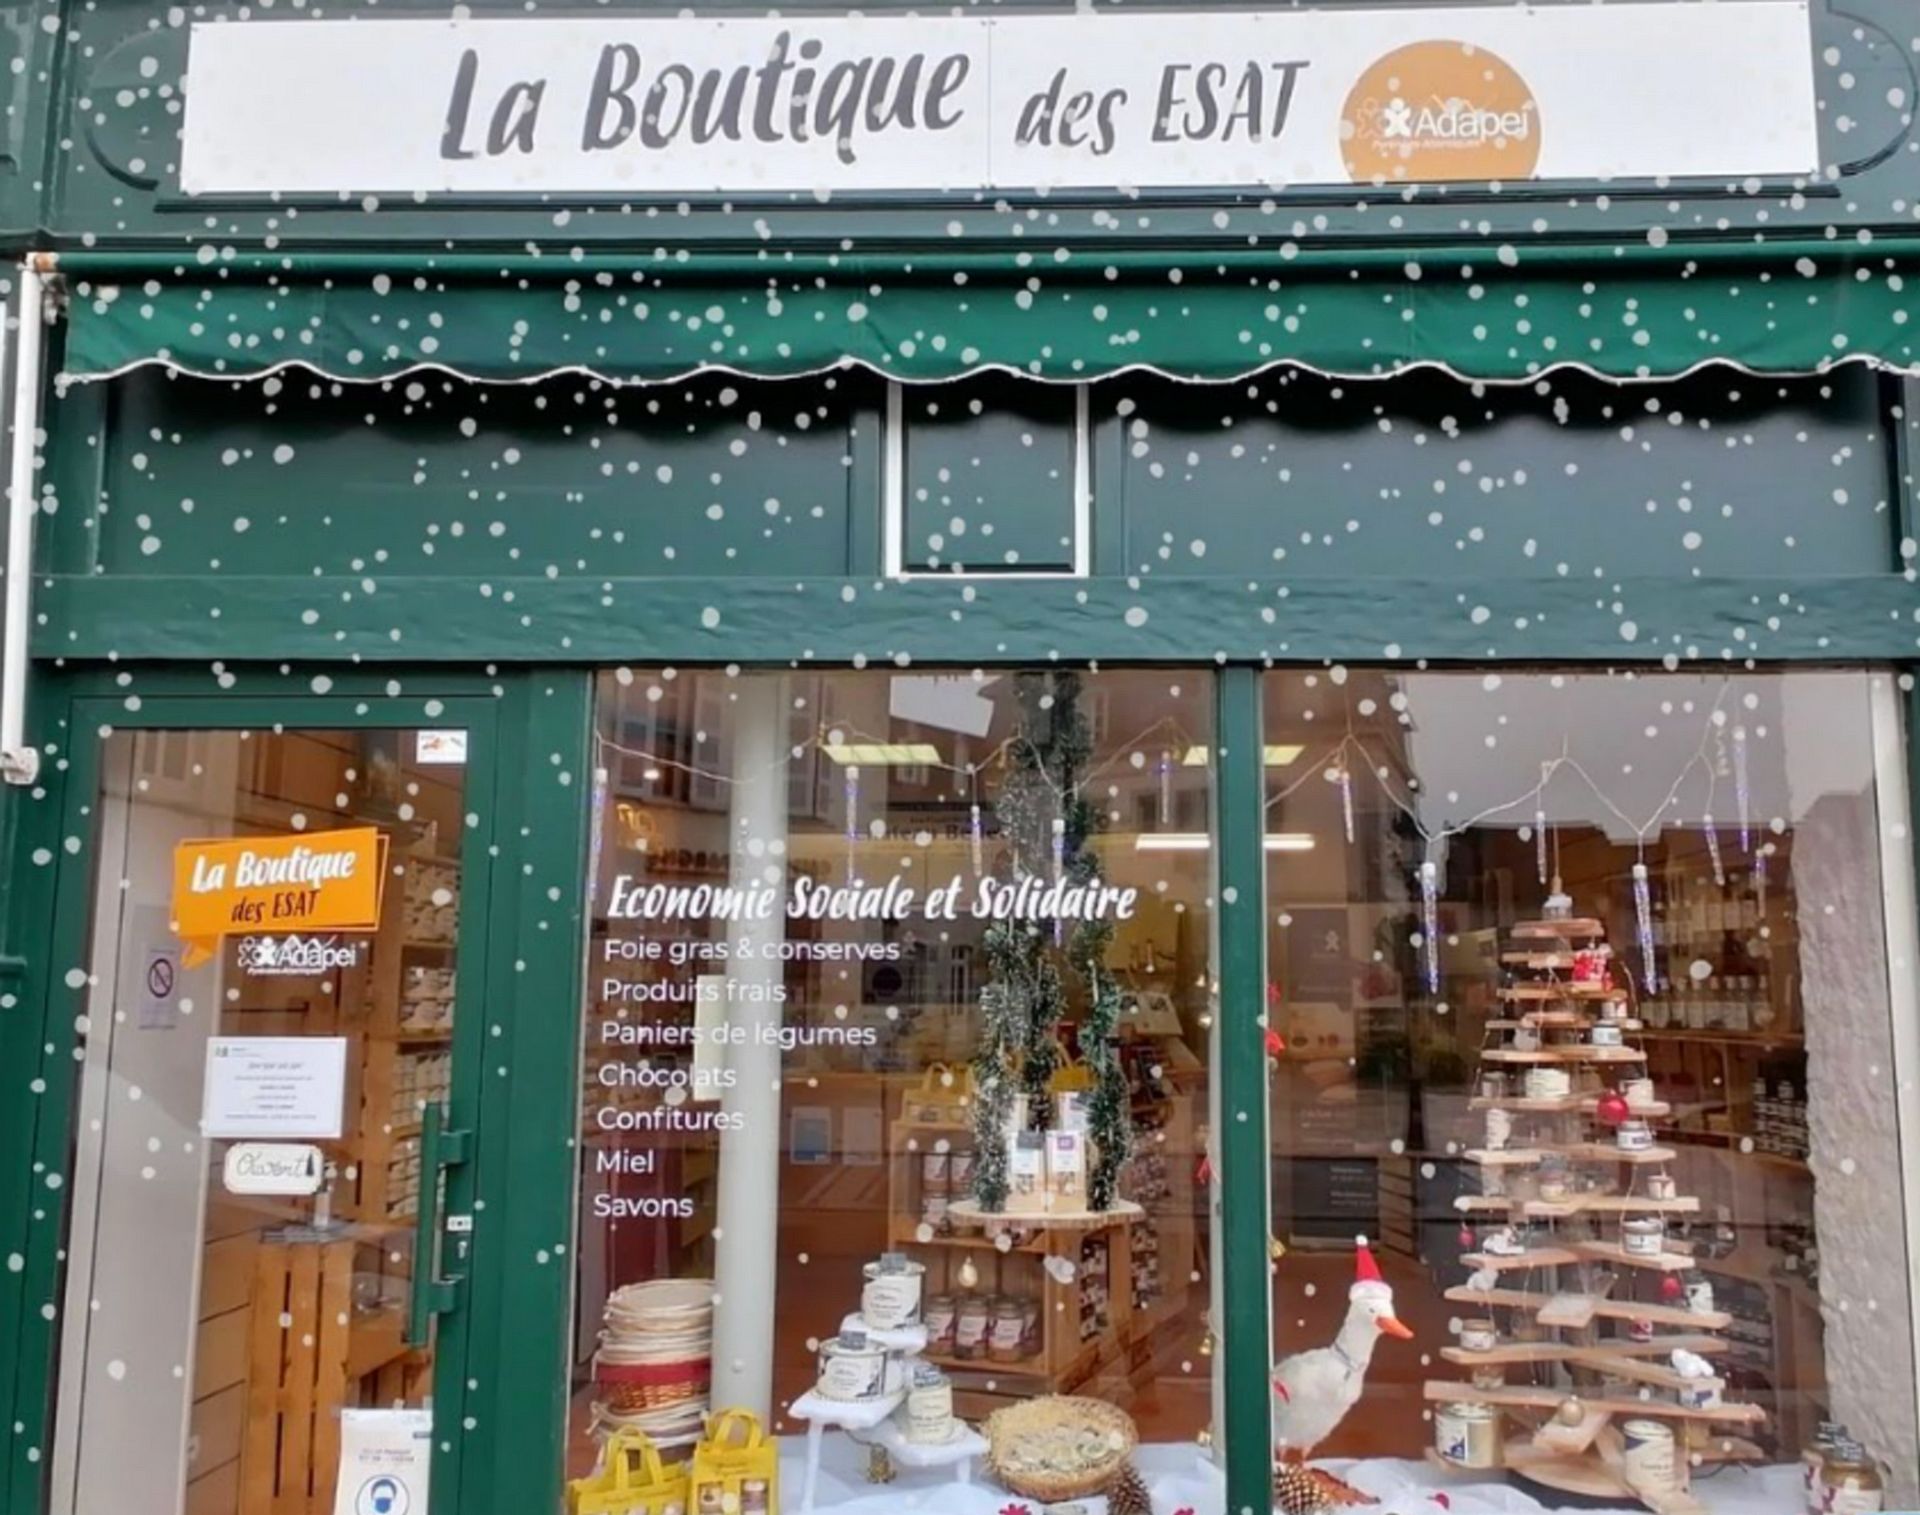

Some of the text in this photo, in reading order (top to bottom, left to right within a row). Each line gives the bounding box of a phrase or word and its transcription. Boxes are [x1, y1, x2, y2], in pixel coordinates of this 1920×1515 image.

[440, 30, 970, 165] La Boutique
[1015, 60, 1311, 156] des ESAT
[1415, 105, 1529, 143] Adapei
[191, 846, 356, 893] La Boutique
[231, 889, 322, 923] des ESAT
[607, 874, 1138, 921] Economie Sociale et Solidaire
[277, 942, 356, 972] Adapei
[604, 936, 900, 966] Foie gras & conserves
[603, 978, 787, 1002] Produits frais
[602, 1020, 878, 1050] Paniers de légumes
[599, 1063, 737, 1088] Chocolats
[597, 1106, 745, 1131] Confitures
[596, 1149, 654, 1174] Miel
[593, 1193, 694, 1218] Savons
